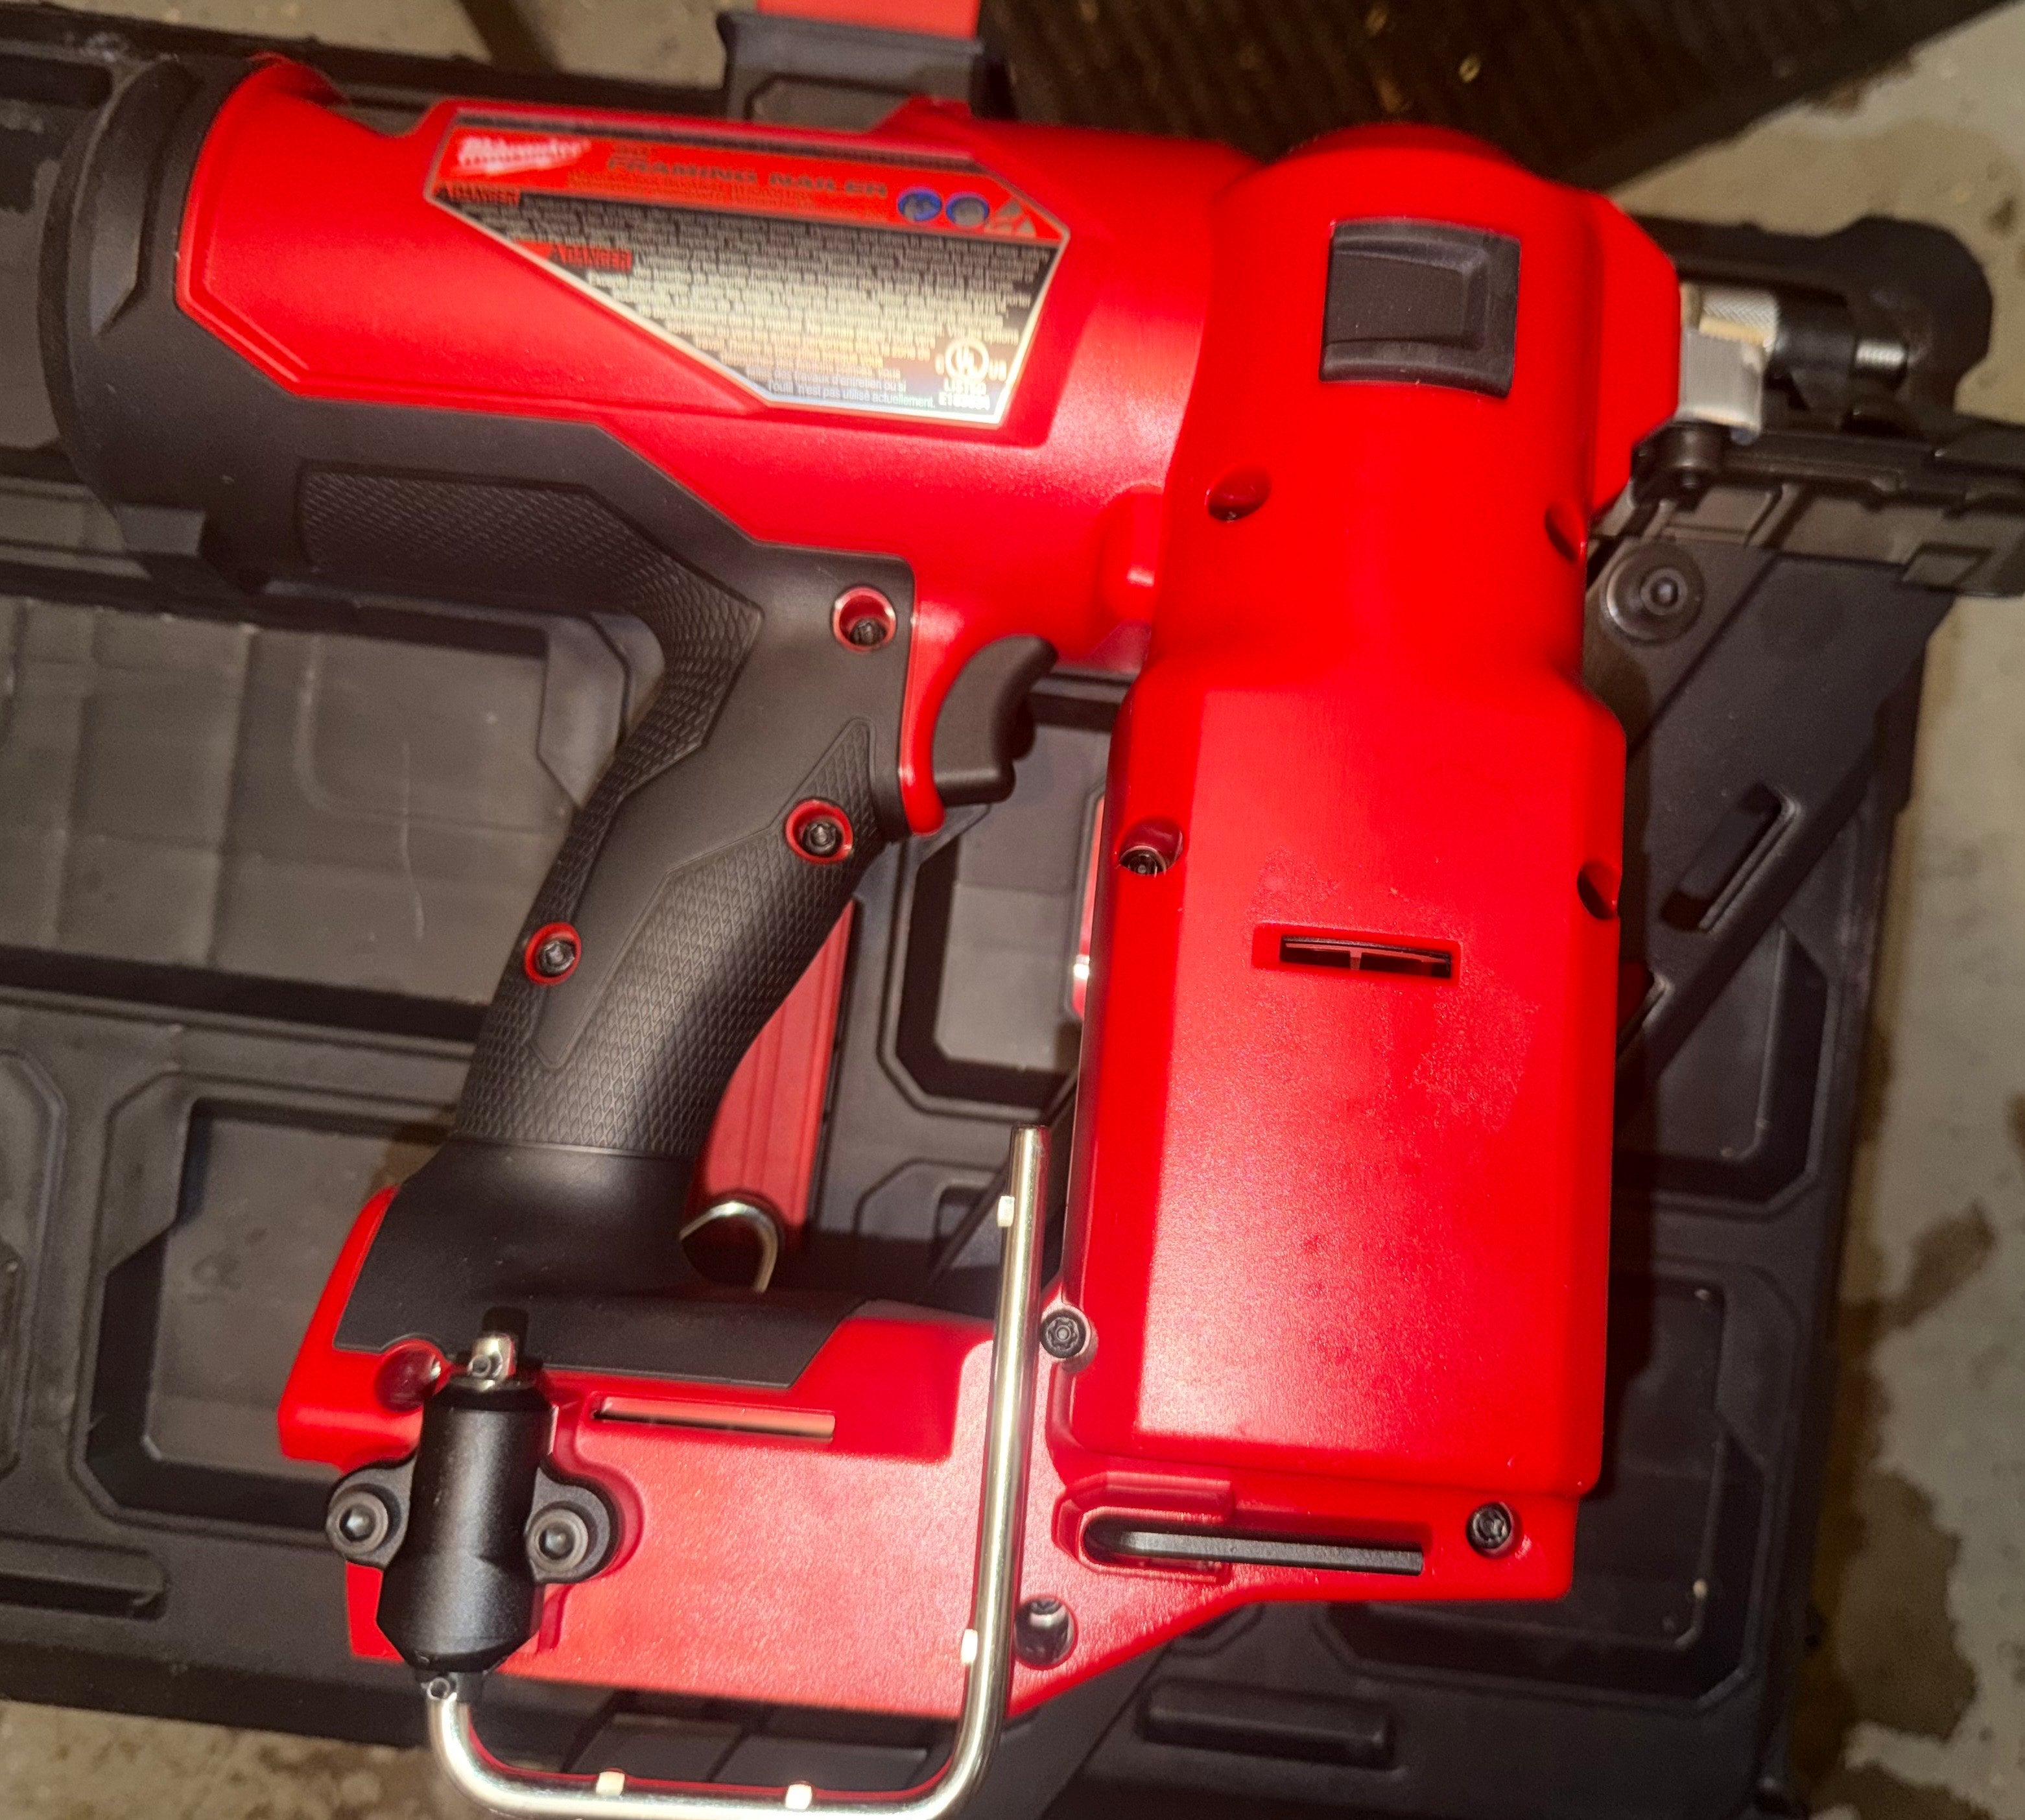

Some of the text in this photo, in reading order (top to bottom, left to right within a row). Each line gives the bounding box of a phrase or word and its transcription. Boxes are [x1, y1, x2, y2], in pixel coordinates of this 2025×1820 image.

[607, 154, 757, 183] FRAMING
[768, 171, 888, 198] NAILER
[563, 245, 630, 270] DANGER
[822, 386, 842, 400] pas
